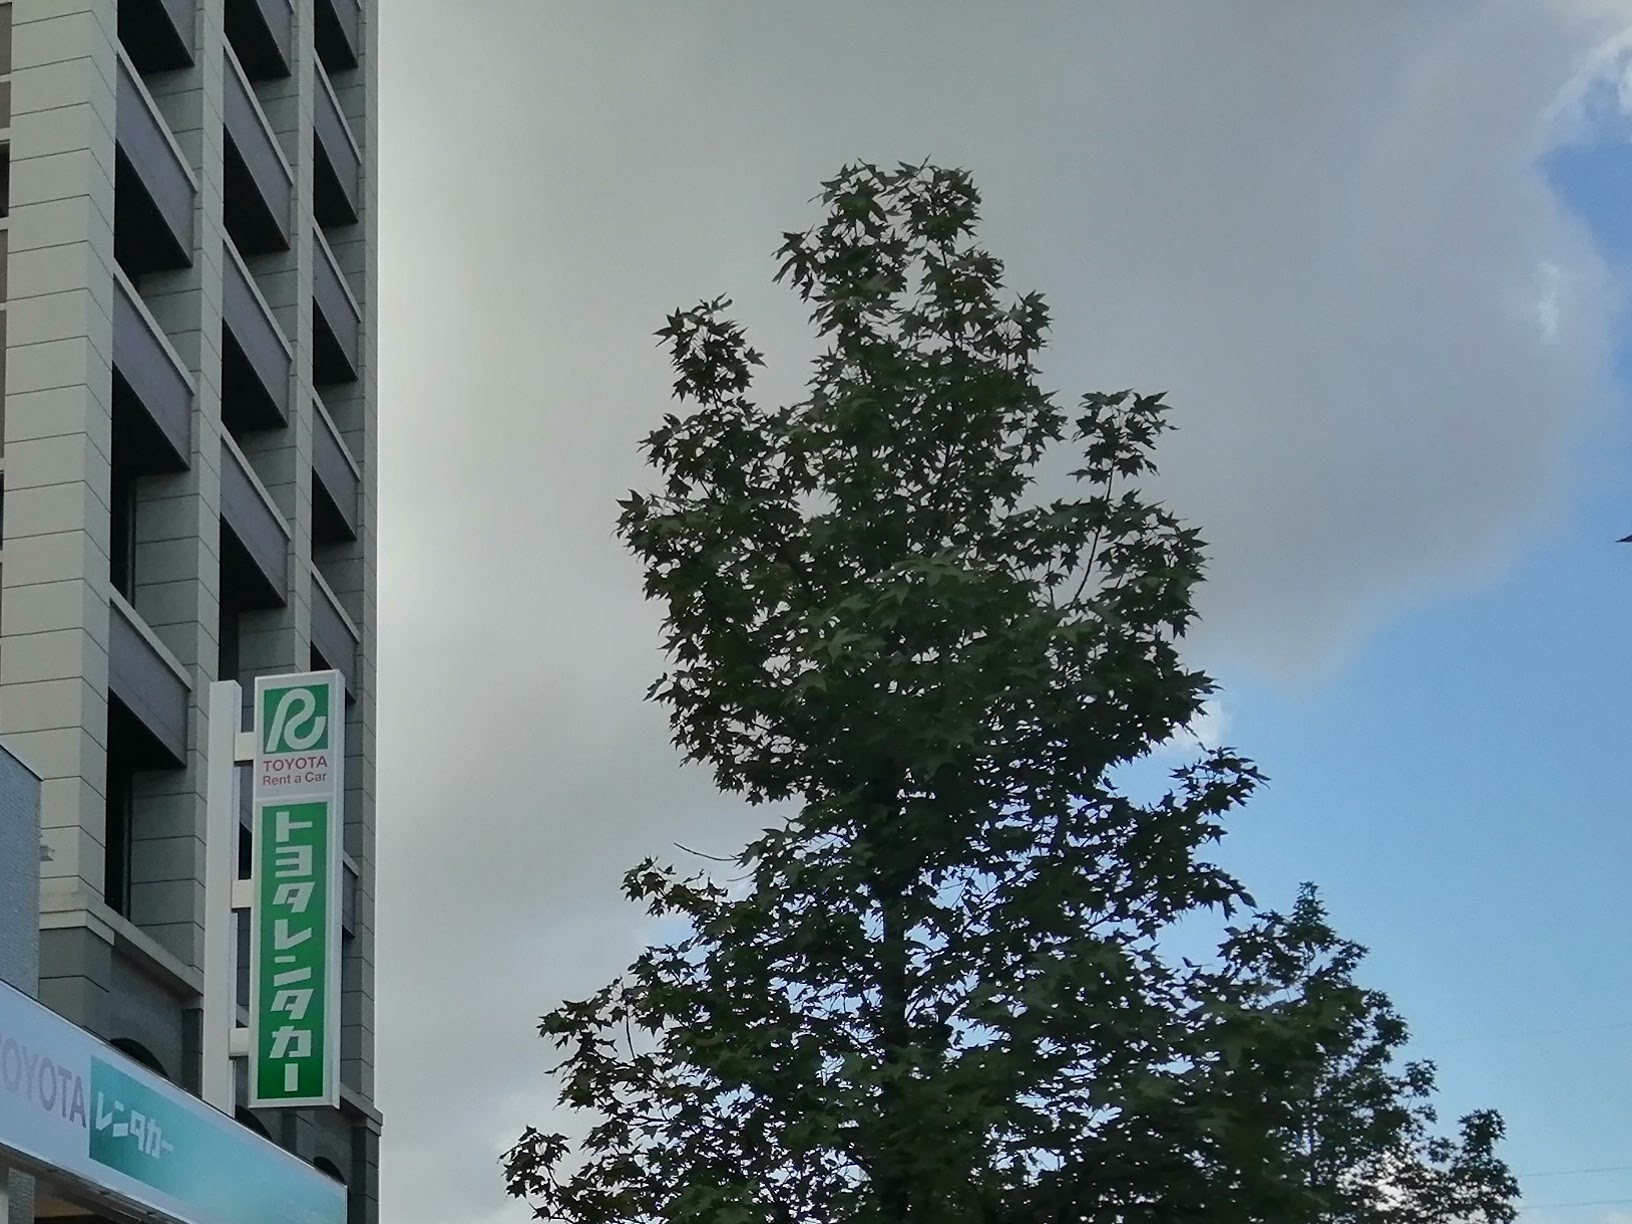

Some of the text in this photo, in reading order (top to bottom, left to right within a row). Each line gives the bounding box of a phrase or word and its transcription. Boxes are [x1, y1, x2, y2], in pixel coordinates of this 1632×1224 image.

[262, 771, 328, 786] Rent a Car
[263, 755, 328, 772] TOYOTA
[268, 810, 316, 1093] トヨタレンタカー
[94, 1090, 175, 1160] レンタカー
